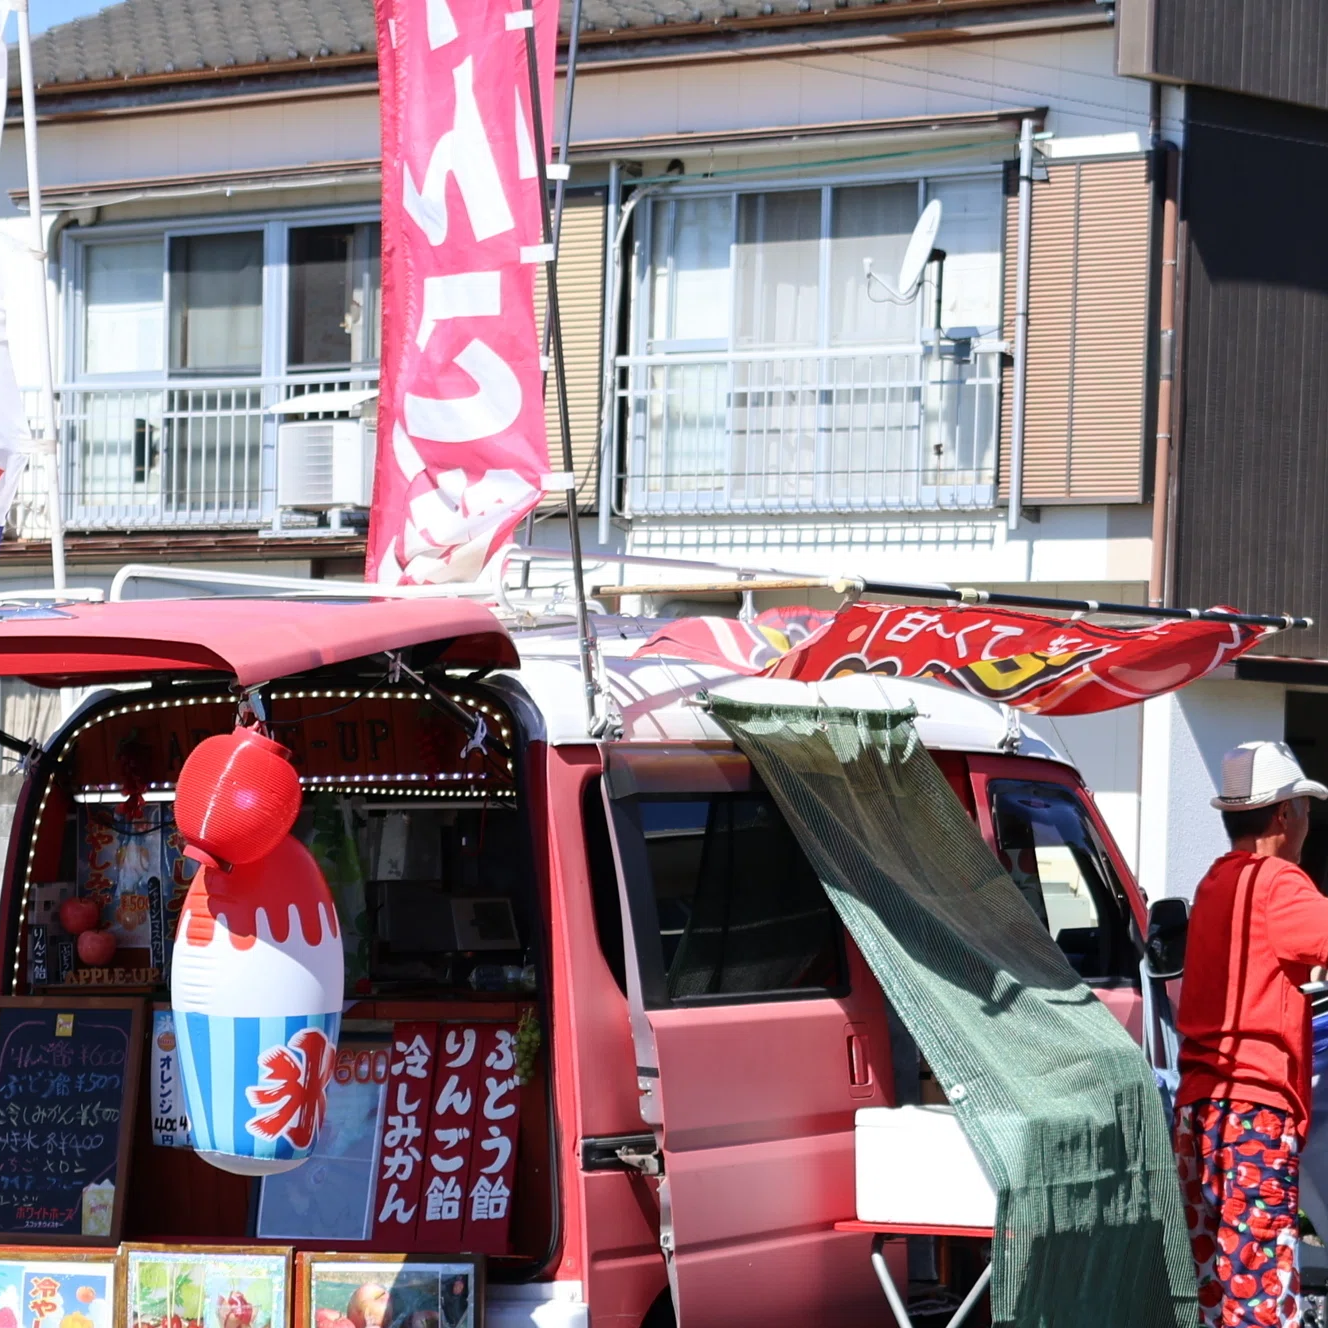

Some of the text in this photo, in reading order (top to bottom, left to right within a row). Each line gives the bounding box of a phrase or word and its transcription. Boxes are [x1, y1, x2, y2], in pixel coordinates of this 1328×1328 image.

[33, 928, 47, 980] りんご飴
[65, 968, 161, 985] APPLE-UP
[160, 1055, 173, 1114] オレンジ
[245, 1027, 336, 1148] 氷
[161, 1134, 174, 1145] 円
[379, 1034, 431, 1224] 冷しみかん
[425, 1028, 476, 1221] りんご飴
[43, 1160, 86, 1173] メロン
